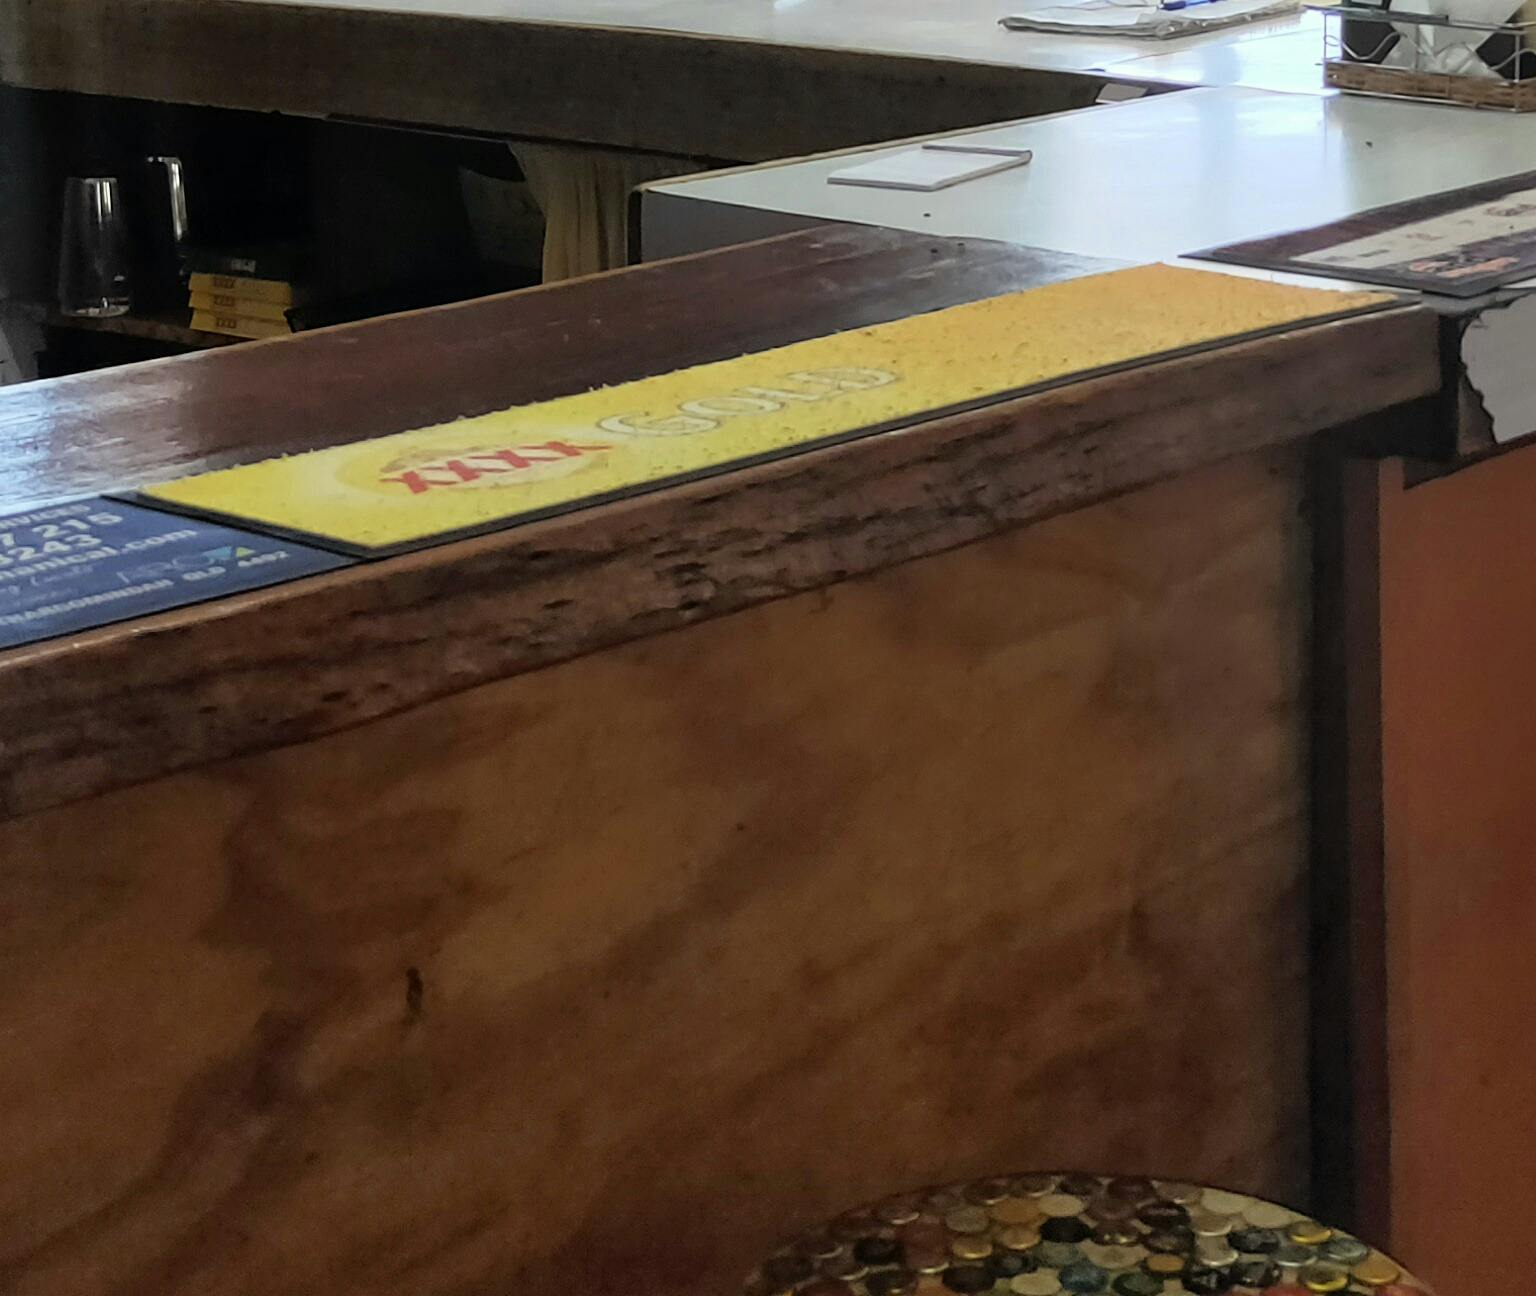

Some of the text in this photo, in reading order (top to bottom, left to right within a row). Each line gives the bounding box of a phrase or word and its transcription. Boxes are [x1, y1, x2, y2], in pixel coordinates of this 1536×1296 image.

[376, 362, 902, 497] XXXX GOLD
[21, 511, 134, 538] 215
